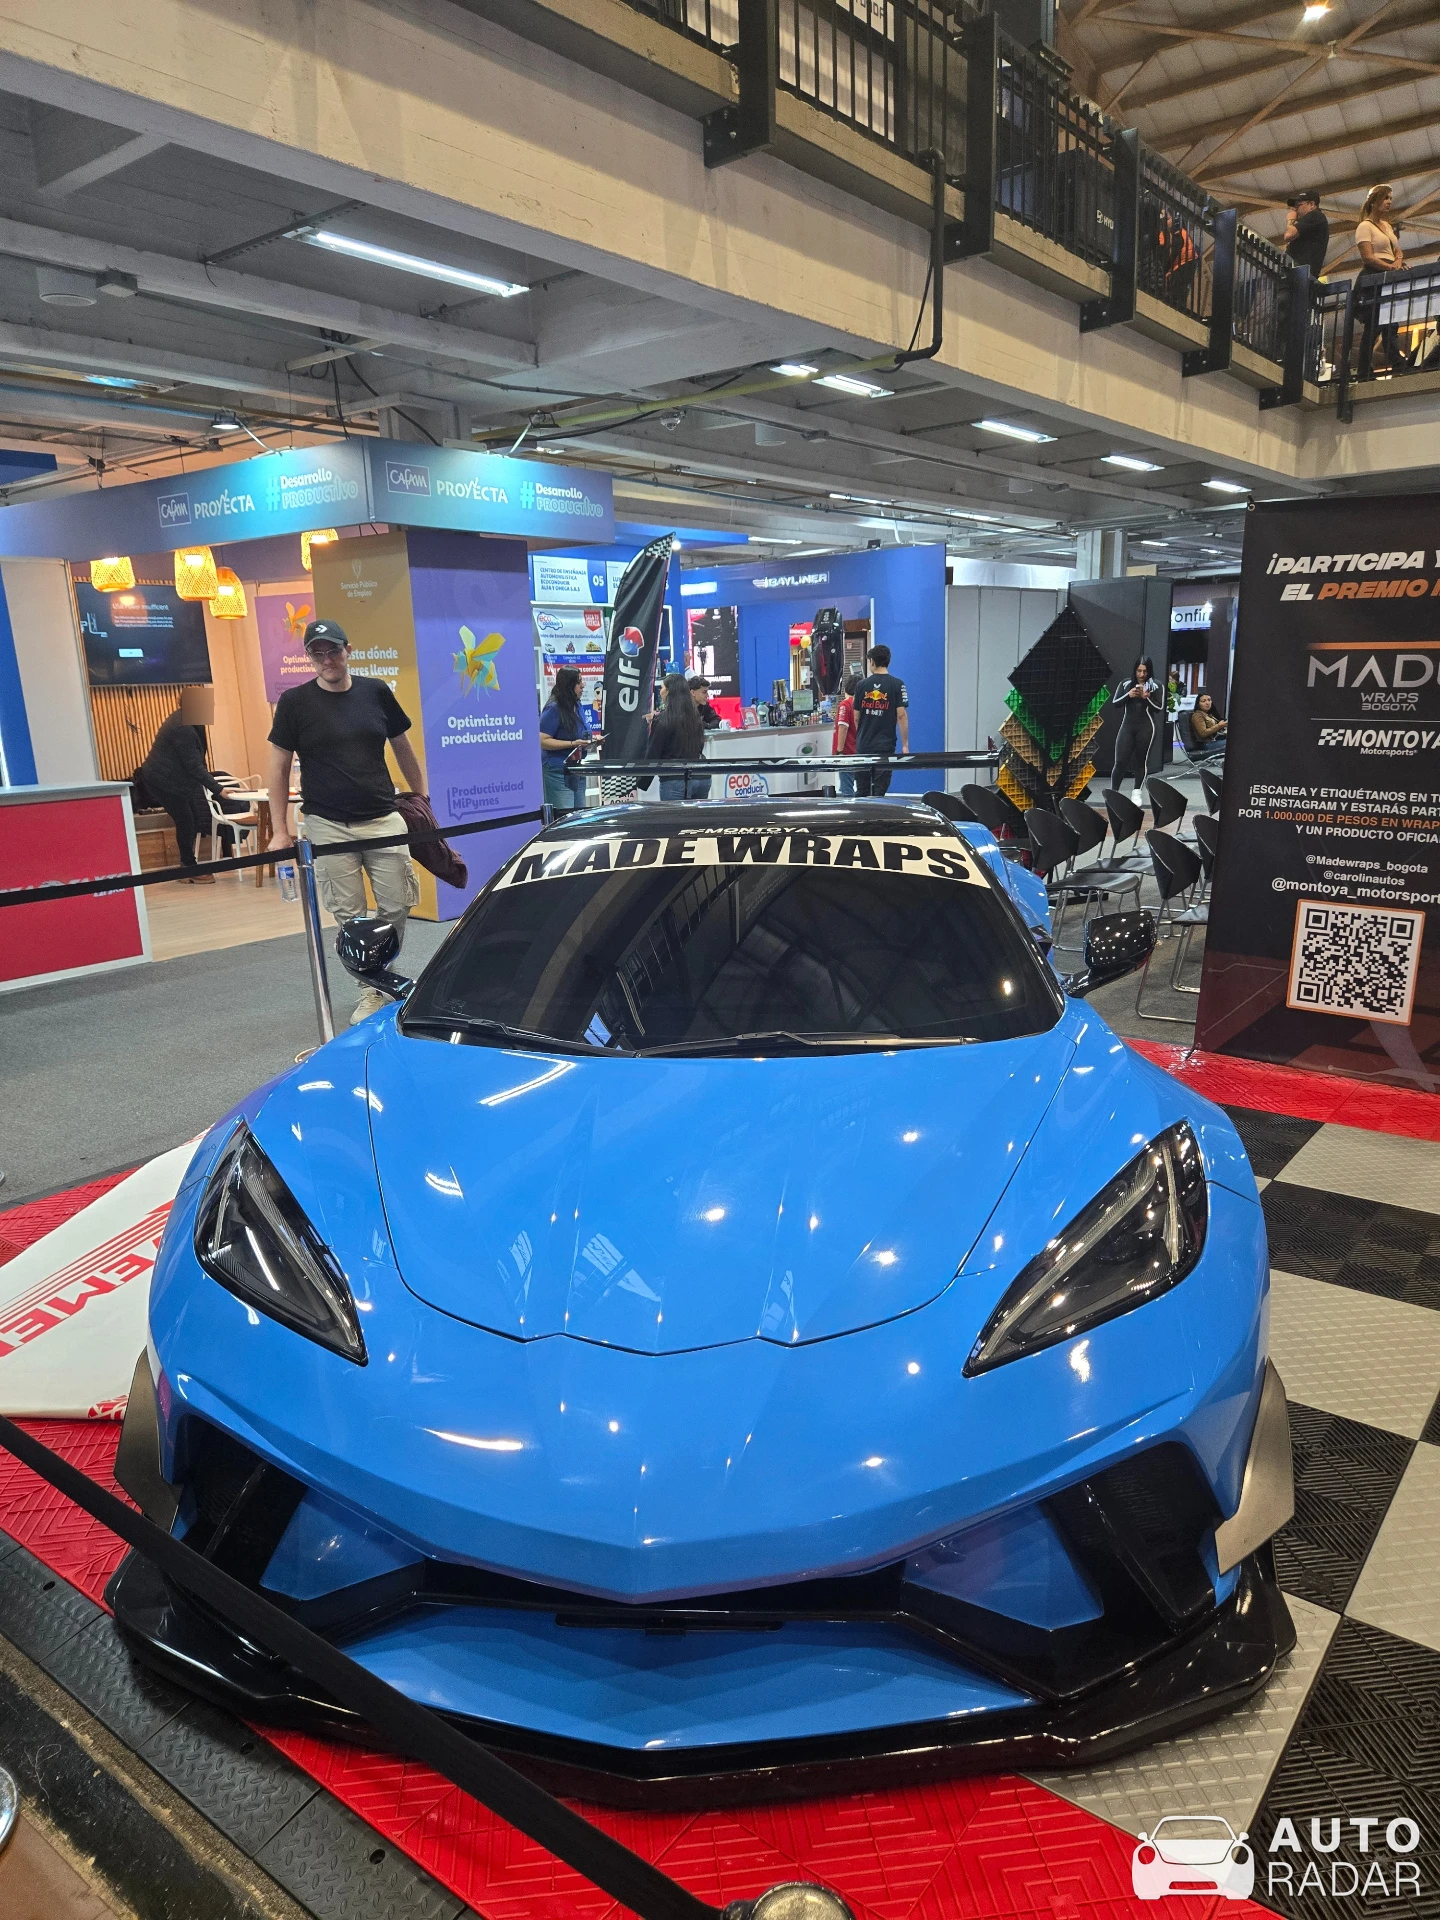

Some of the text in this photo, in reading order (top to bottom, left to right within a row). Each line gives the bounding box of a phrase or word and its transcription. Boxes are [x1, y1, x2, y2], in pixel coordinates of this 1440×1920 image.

[436, 477, 509, 504] PROYECTA
[194, 489, 255, 519] PROYECTA
[1266, 550, 1425, 575] ¡PARTICIPA
[592, 575, 604, 587] 05
[768, 573, 828, 587] BAYLINER
[1280, 583, 1315, 602] EL
[1317, 578, 1429, 600] PREMIO
[283, 655, 310, 665] Optimiz
[367, 645, 398, 660] dónde
[370, 664, 399, 676] llevar
[1307, 654, 1440, 688] MAD
[617, 657, 641, 712] elf
[861, 700, 889, 710] Red Bull
[1360, 692, 1419, 703] WRAPS
[1361, 703, 1416, 711] BOGOTA
[447, 714, 516, 731] Optimiza tu
[441, 729, 523, 747] productividad
[451, 781, 524, 797] Productividad
[729, 774, 750, 789] eco
[735, 783, 764, 796] conducir
[452, 795, 500, 811] MiPymes
[1249, 785, 1440, 804] ¡ESCANEA Y ETIQUÉTANOS EN T
[1250, 797, 1266, 807] DE
[1268, 798, 1337, 812] INSTAGRAM
[1340, 802, 1348, 812] Y
[1351, 802, 1408, 815] ESTARÁS
[1238, 808, 1262, 819] POR
[1264, 810, 1315, 823] 1.000.000
[1317, 814, 1334, 824] DE
[1336, 815, 1378, 827] PESOS
[1381, 817, 1398, 828] EN
[1295, 824, 1440, 844] Y UN PRODUCTO OFICIA
[511, 834, 970, 884] MADE WRAPS
[1305, 854, 1429, 874] @Madewraps_bogota
[1323, 870, 1406, 886] @carolinautos
